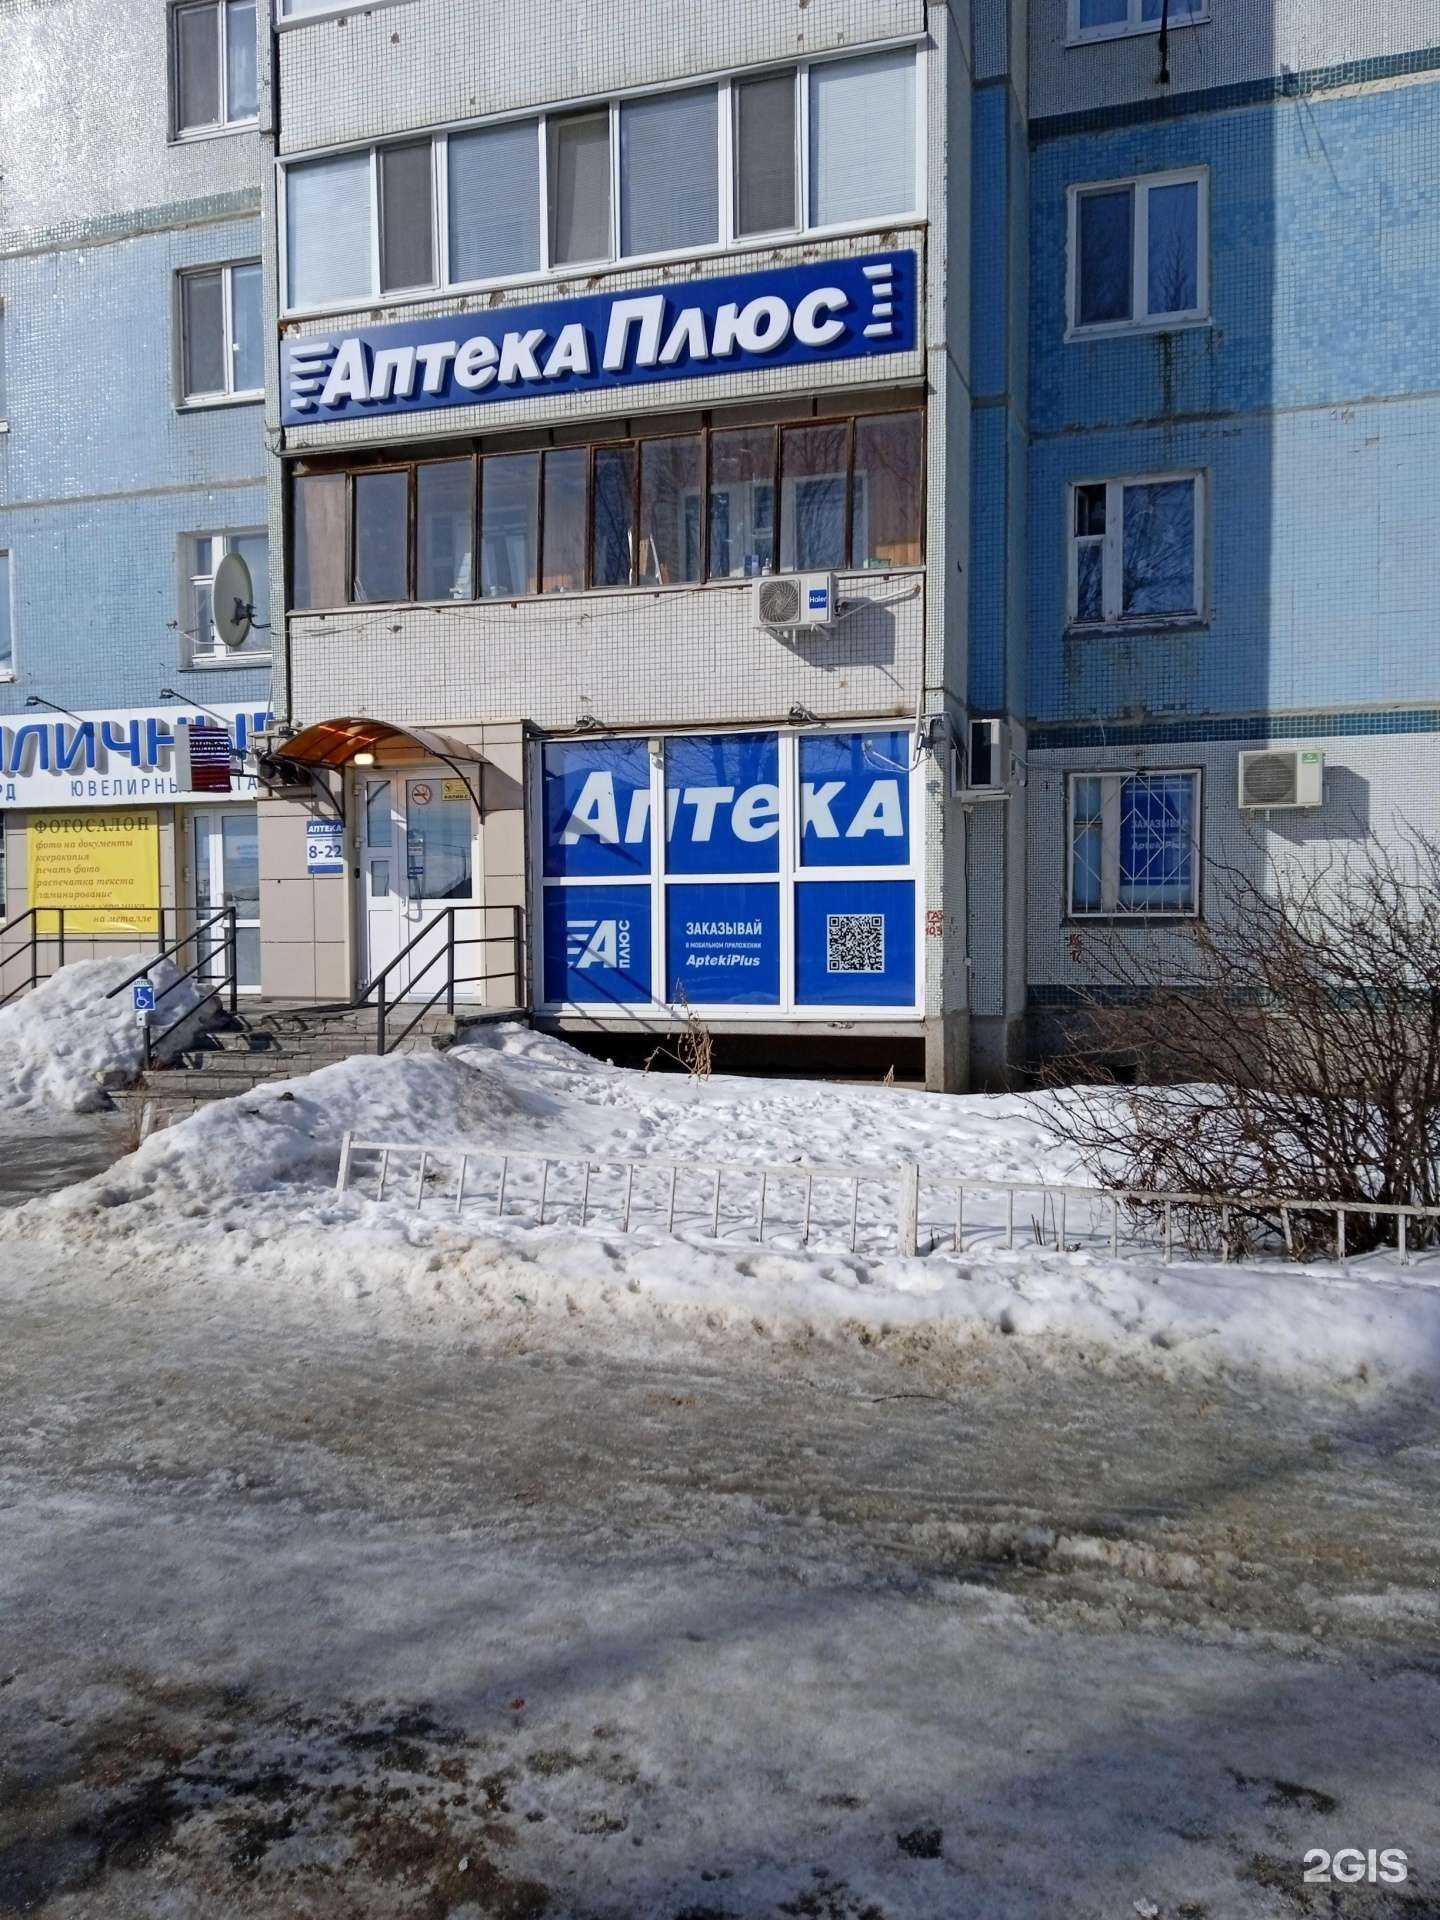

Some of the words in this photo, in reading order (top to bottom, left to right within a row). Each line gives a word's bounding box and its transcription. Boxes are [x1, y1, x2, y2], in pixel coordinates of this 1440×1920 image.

[602, 287, 851, 372] Плюс
[809, 595, 827, 603] Haier
[35, 816, 149, 834] ФОТОСАЛОН
[35, 840, 62, 851] фото
[78, 839, 133, 850] документы
[309, 845, 342, 858] 8-22
[36, 866, 71, 874] печать
[74, 864, 100, 874] фото
[36, 879, 94, 888] распечатка
[96, 878, 134, 886] текста
[686, 918, 762, 935] ЗАКАЗЫВАЙ
[618, 920, 630, 968] ПЛЮС
[686, 954, 760, 968] AptekiPlus
